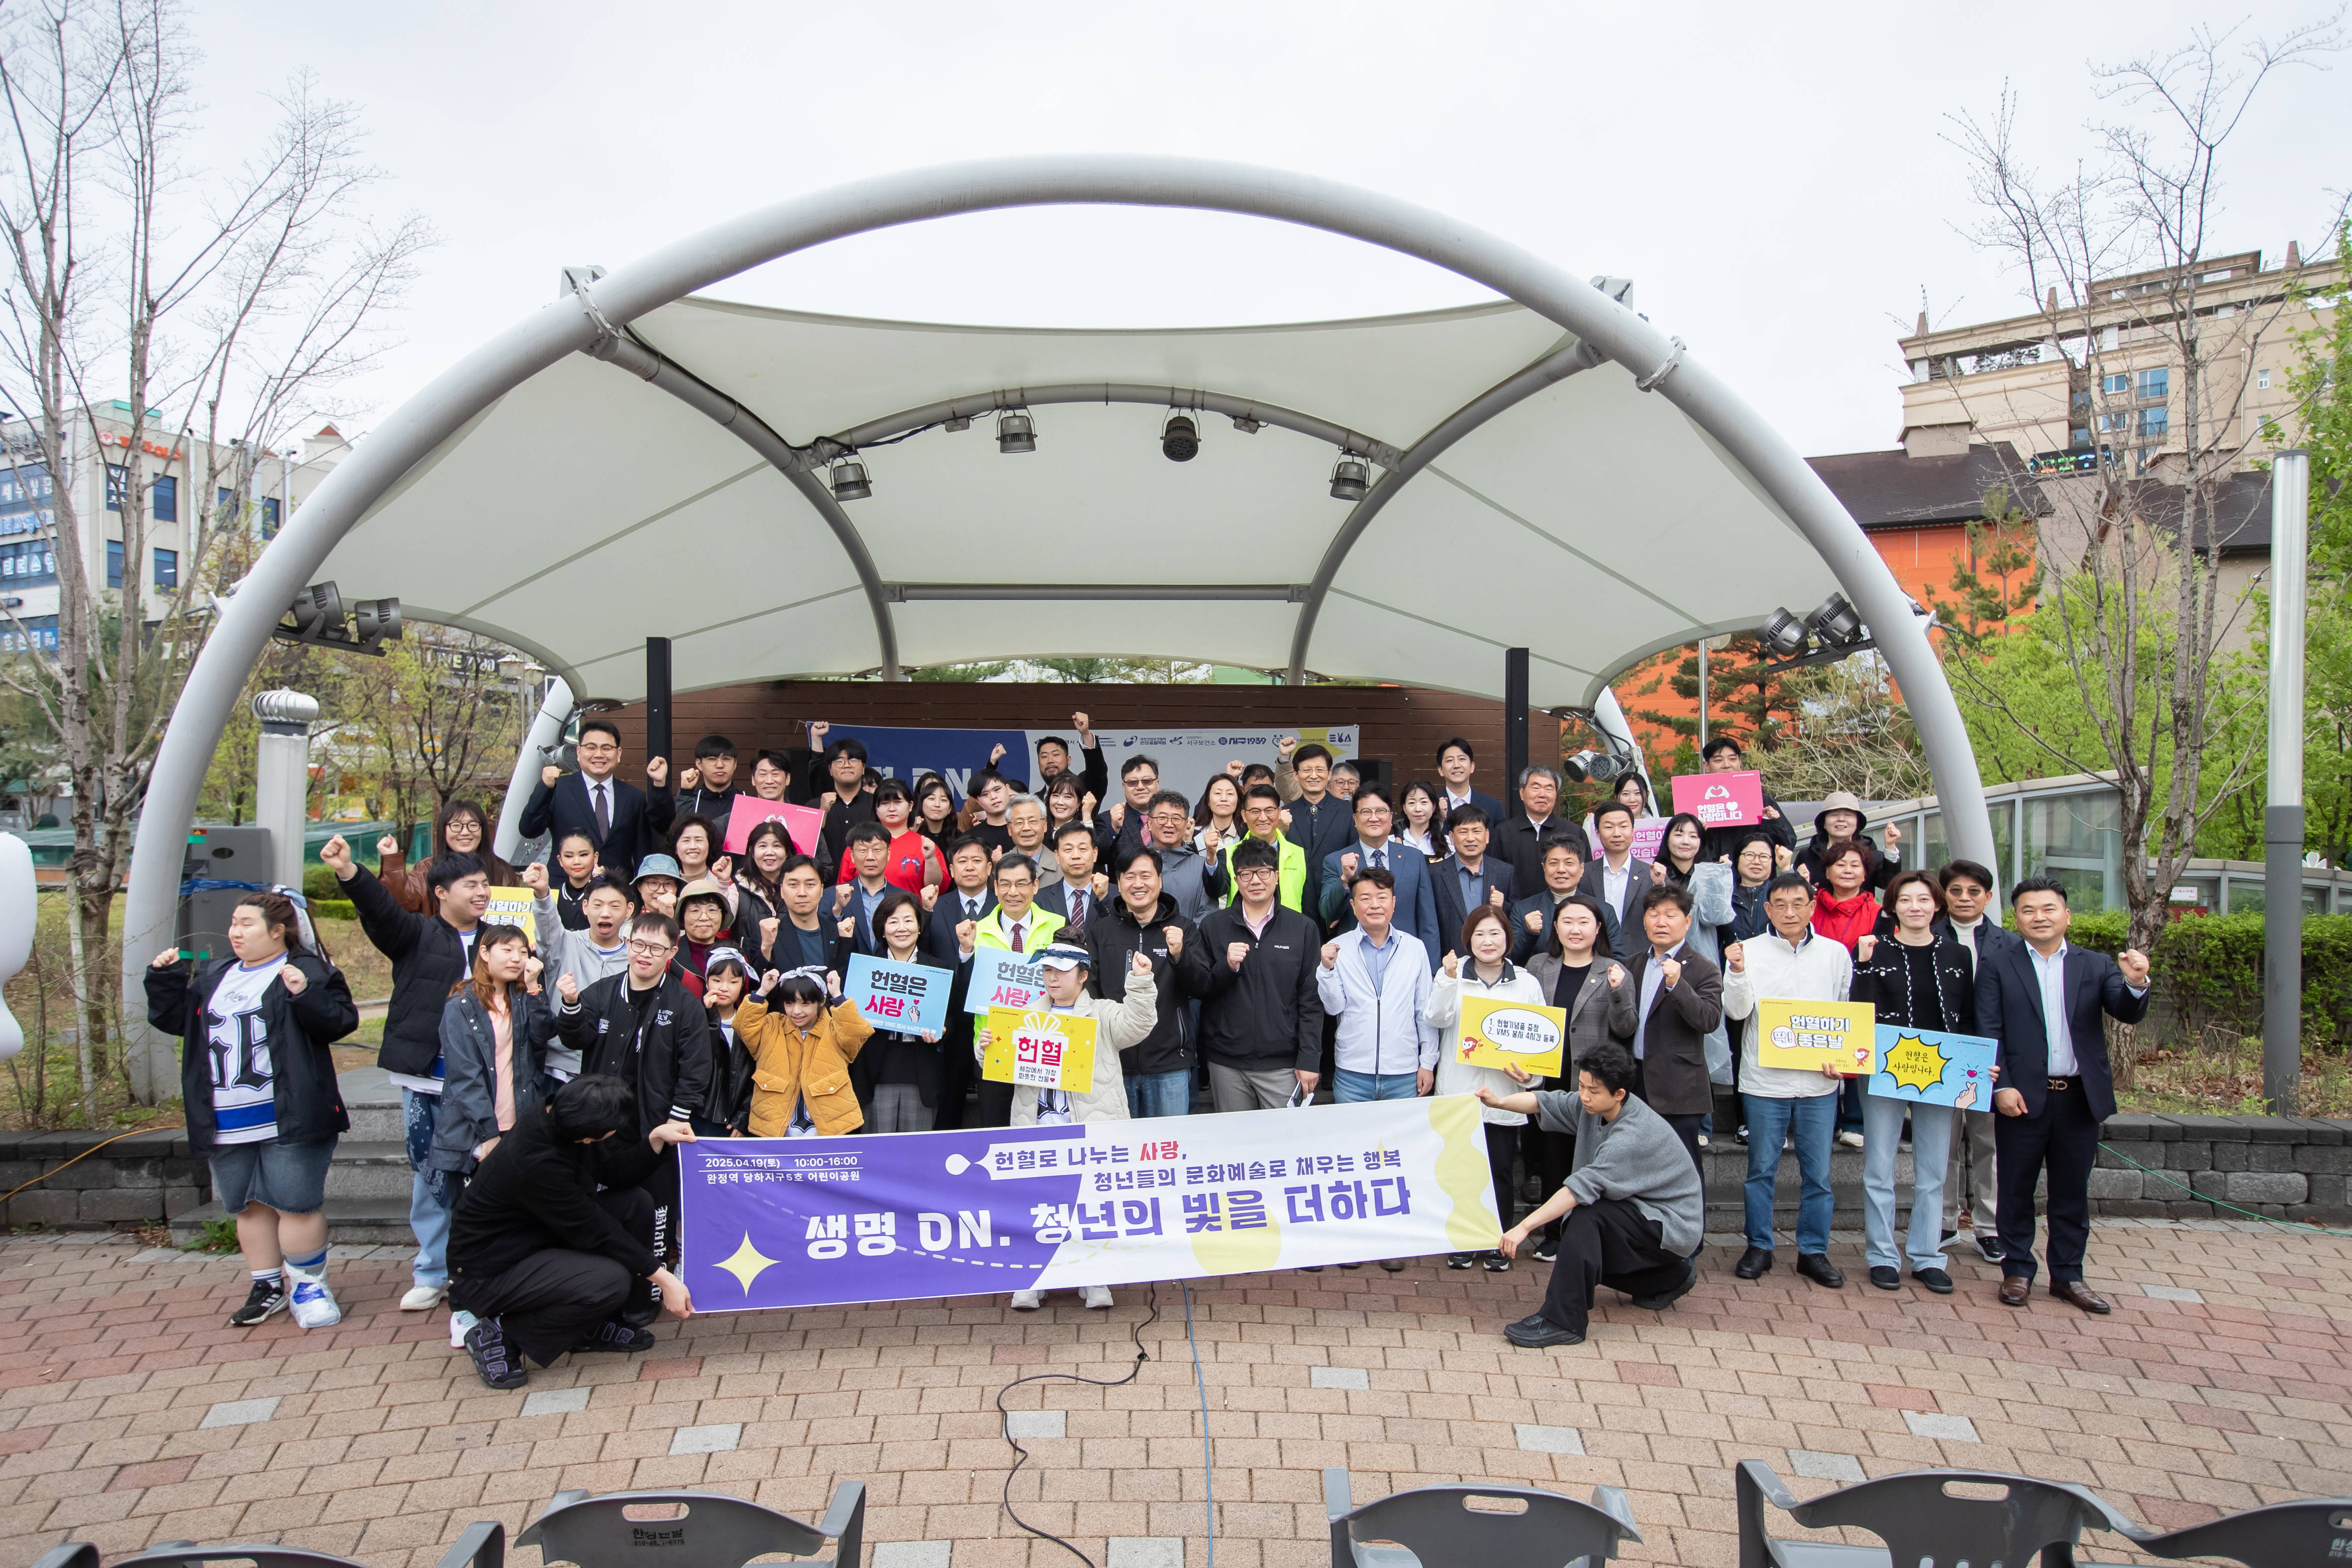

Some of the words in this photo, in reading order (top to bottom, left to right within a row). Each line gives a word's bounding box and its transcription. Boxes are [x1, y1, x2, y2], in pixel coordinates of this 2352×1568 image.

[1696, 803, 1725, 814] 헌혈은
[1698, 810, 1743, 822] 사랑입니다
[486, 914, 528, 927] 좋은날
[871, 970, 927, 998] 헌혈은
[991, 985, 1031, 1008] 사랑
[864, 994, 905, 1018] 사랑
[1490, 1018, 1495, 1027] 1.
[1497, 1019, 1525, 1031] 헌혈기념품
[1527, 1024, 1539, 1032] 증정
[1790, 1015, 1850, 1033] 헌혈하기
[1488, 1027, 1494, 1035] 2.
[1497, 1028, 1510, 1037] VMS
[1512, 1030, 1523, 1039] 봉사
[1525, 1032, 1541, 1042] 4시간
[1543, 1035, 1554, 1043] 등록
[1773, 1031, 1793, 1043] 딱!
[1797, 1033, 1844, 1049] 좋은날
[1018, 1037, 1062, 1066] 헌혈
[1905, 1050, 1929, 1062] 헌혈은
[1019, 1065, 1042, 1074] 세상에서
[1892, 1061, 1934, 1076] 사랑입니다.
[705, 1158, 780, 1169] 2025.04.19(토)
[794, 1156, 857, 1167] 10:00-16:00
[995, 1150, 1057, 1171] 헌혈로
[1068, 1145, 1129, 1166] 나누는
[1140, 1141, 1187, 1161] 사랑,
[707, 1172, 739, 1184] 완정역
[743, 1172, 804, 1183] 당하지구5호
[808, 1171, 860, 1182] 어린이공원
[1094, 1168, 1176, 1192] 청년들의
[1186, 1160, 1287, 1185] 문화예술로
[1296, 1154, 1354, 1176] 채우는
[1363, 1150, 1401, 1170] 행복
[805, 1212, 896, 1259] 생명
[1030, 1197, 1163, 1244] 청년의
[1182, 1190, 1268, 1233] 빛을
[1284, 1176, 1411, 1223] 더하다
[654, 1205, 668, 1257] Black
